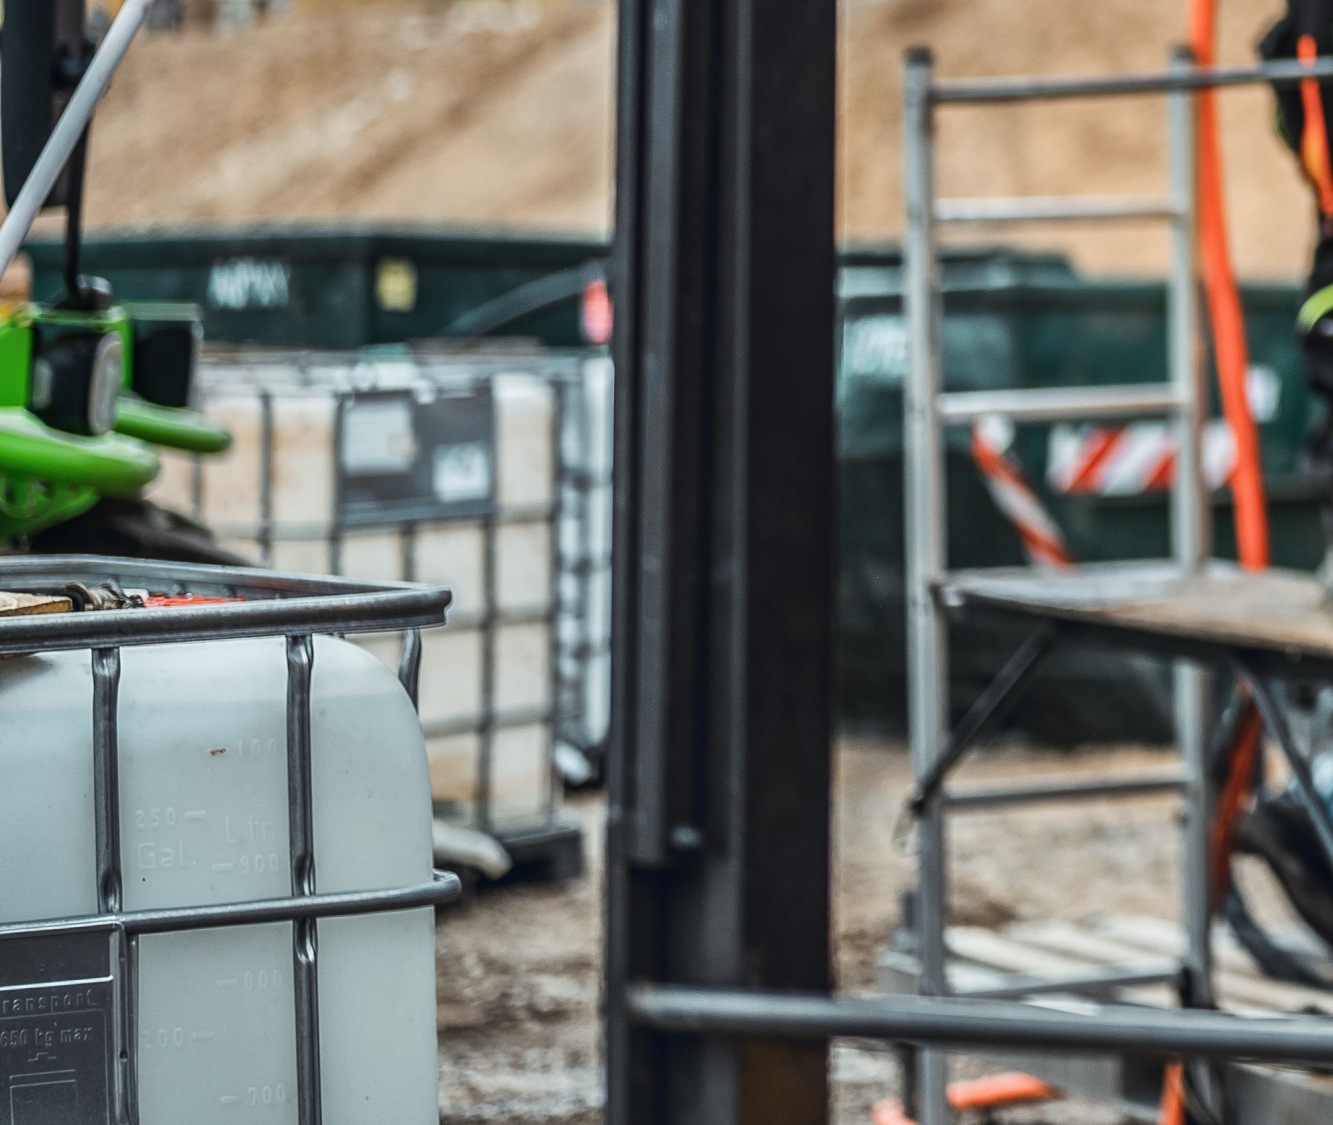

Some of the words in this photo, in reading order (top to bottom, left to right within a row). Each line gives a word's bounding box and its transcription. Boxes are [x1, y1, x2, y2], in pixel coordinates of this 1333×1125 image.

[135, 807, 176, 828] 250
[240, 853, 279, 874] 900
[2, 989, 99, 1013] ransport
